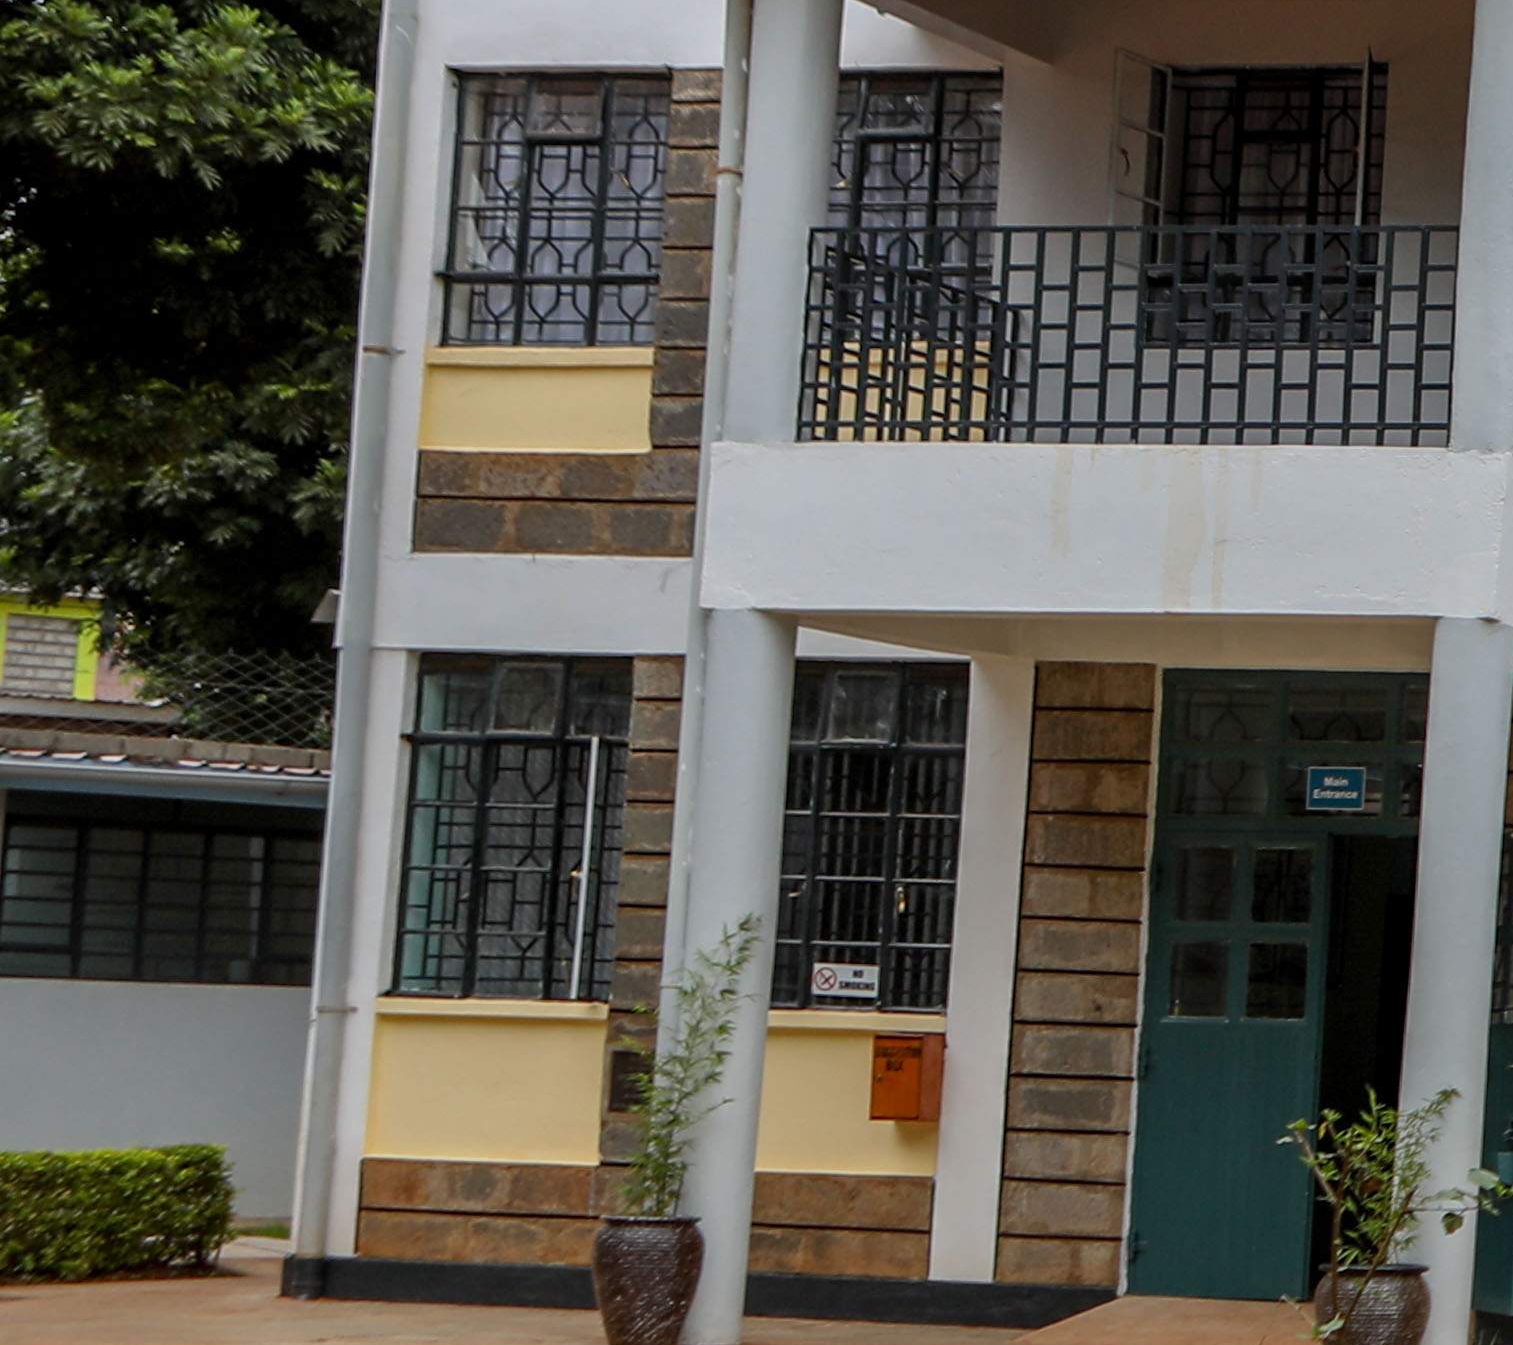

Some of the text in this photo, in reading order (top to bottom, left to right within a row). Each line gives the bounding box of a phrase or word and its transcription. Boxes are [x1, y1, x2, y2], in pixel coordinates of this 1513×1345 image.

[1324, 777, 1349, 786] Main
[1313, 788, 1358, 799] Entrance
[853, 970, 863, 978] NO
[839, 981, 875, 991] SMOKING
